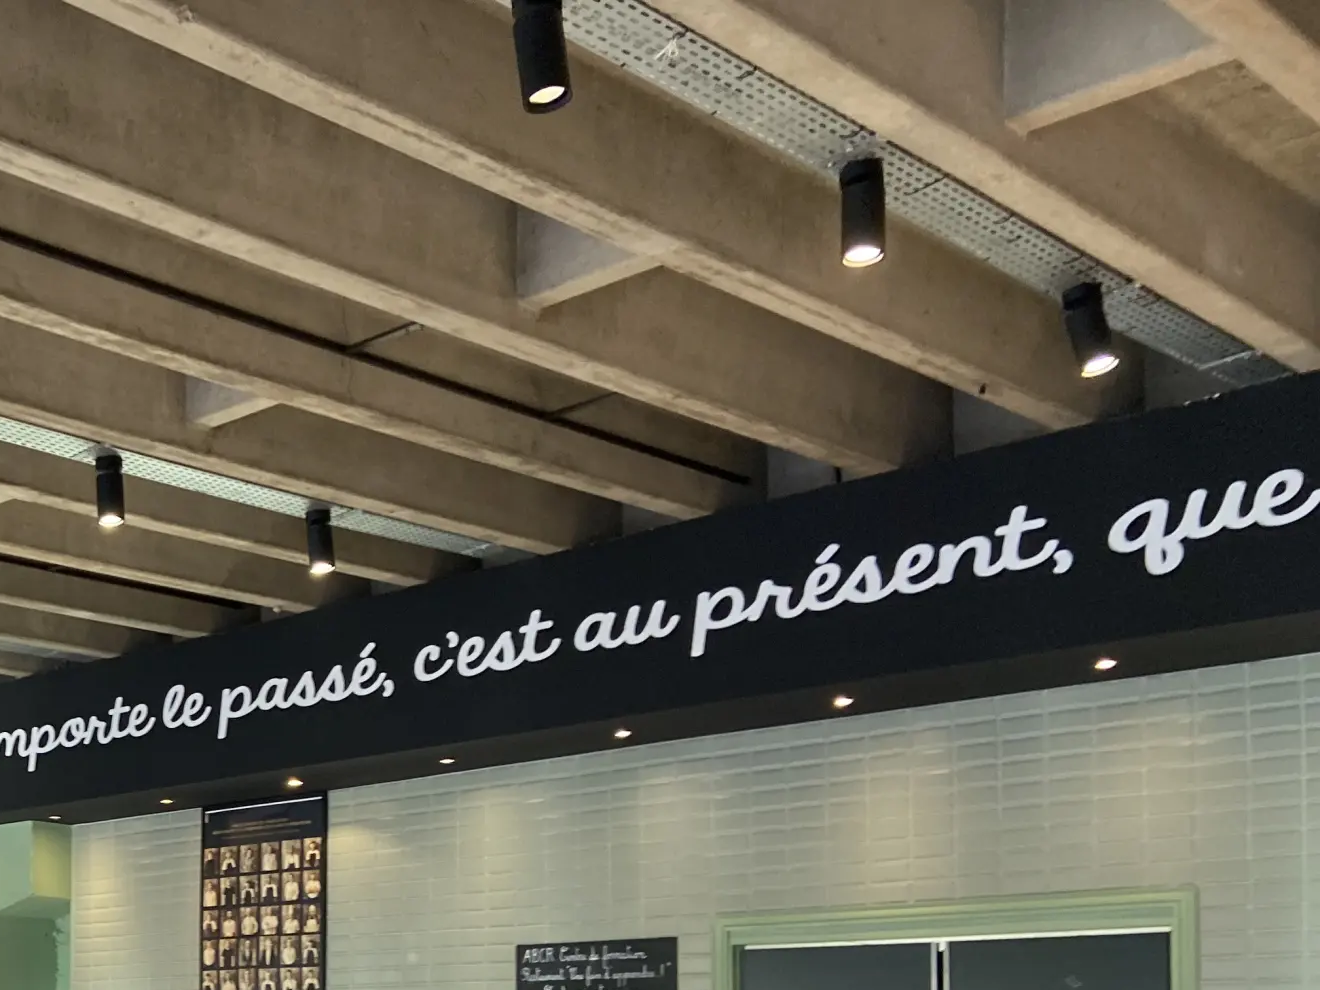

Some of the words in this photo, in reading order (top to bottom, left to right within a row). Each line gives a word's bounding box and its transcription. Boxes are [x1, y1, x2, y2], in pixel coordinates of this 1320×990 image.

[162, 684, 211, 729] le
[217, 642, 395, 739] passé,
[414, 609, 561, 681] c'est
[574, 600, 680, 652] au
[690, 505, 1074, 657] présent,
[1108, 468, 1320, 576] que
